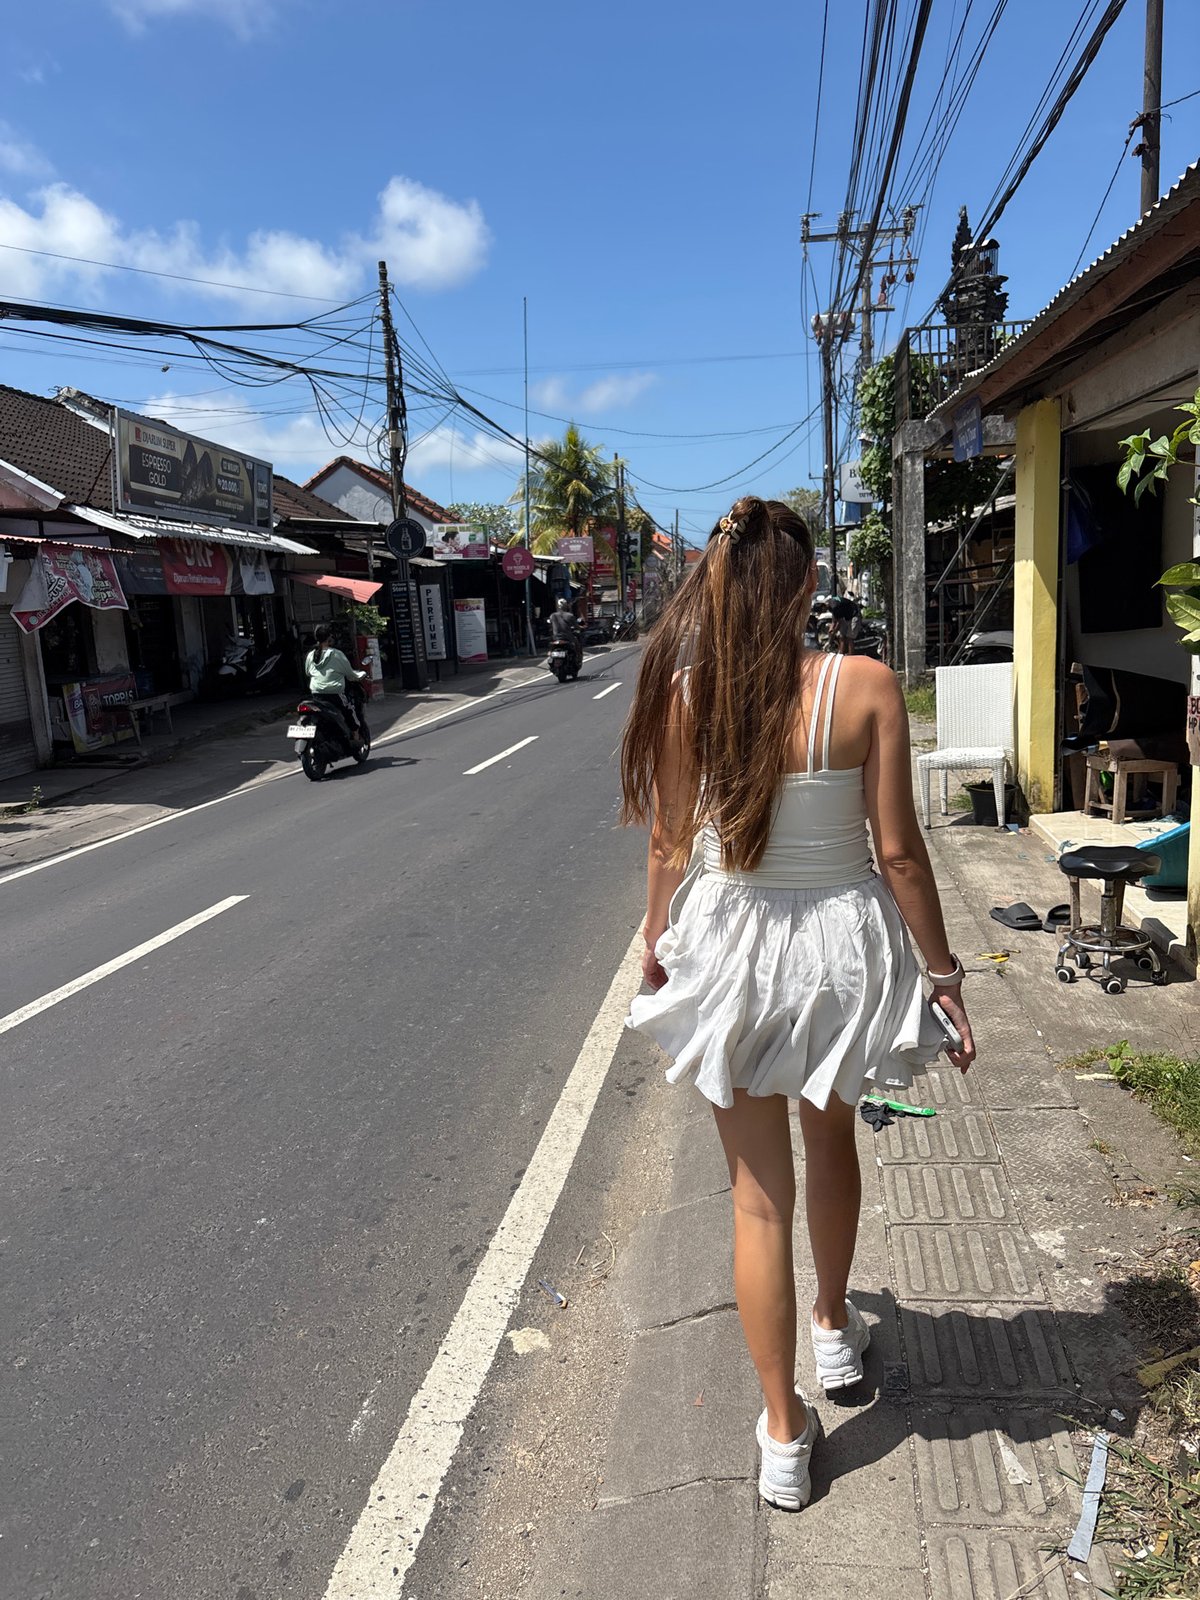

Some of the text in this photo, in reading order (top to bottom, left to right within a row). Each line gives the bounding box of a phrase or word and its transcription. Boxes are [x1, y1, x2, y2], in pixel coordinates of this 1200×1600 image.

[142, 452, 172, 474] ESPRESSO
[148, 471, 167, 486] GOLD
[425, 588, 437, 650] PERFUME
